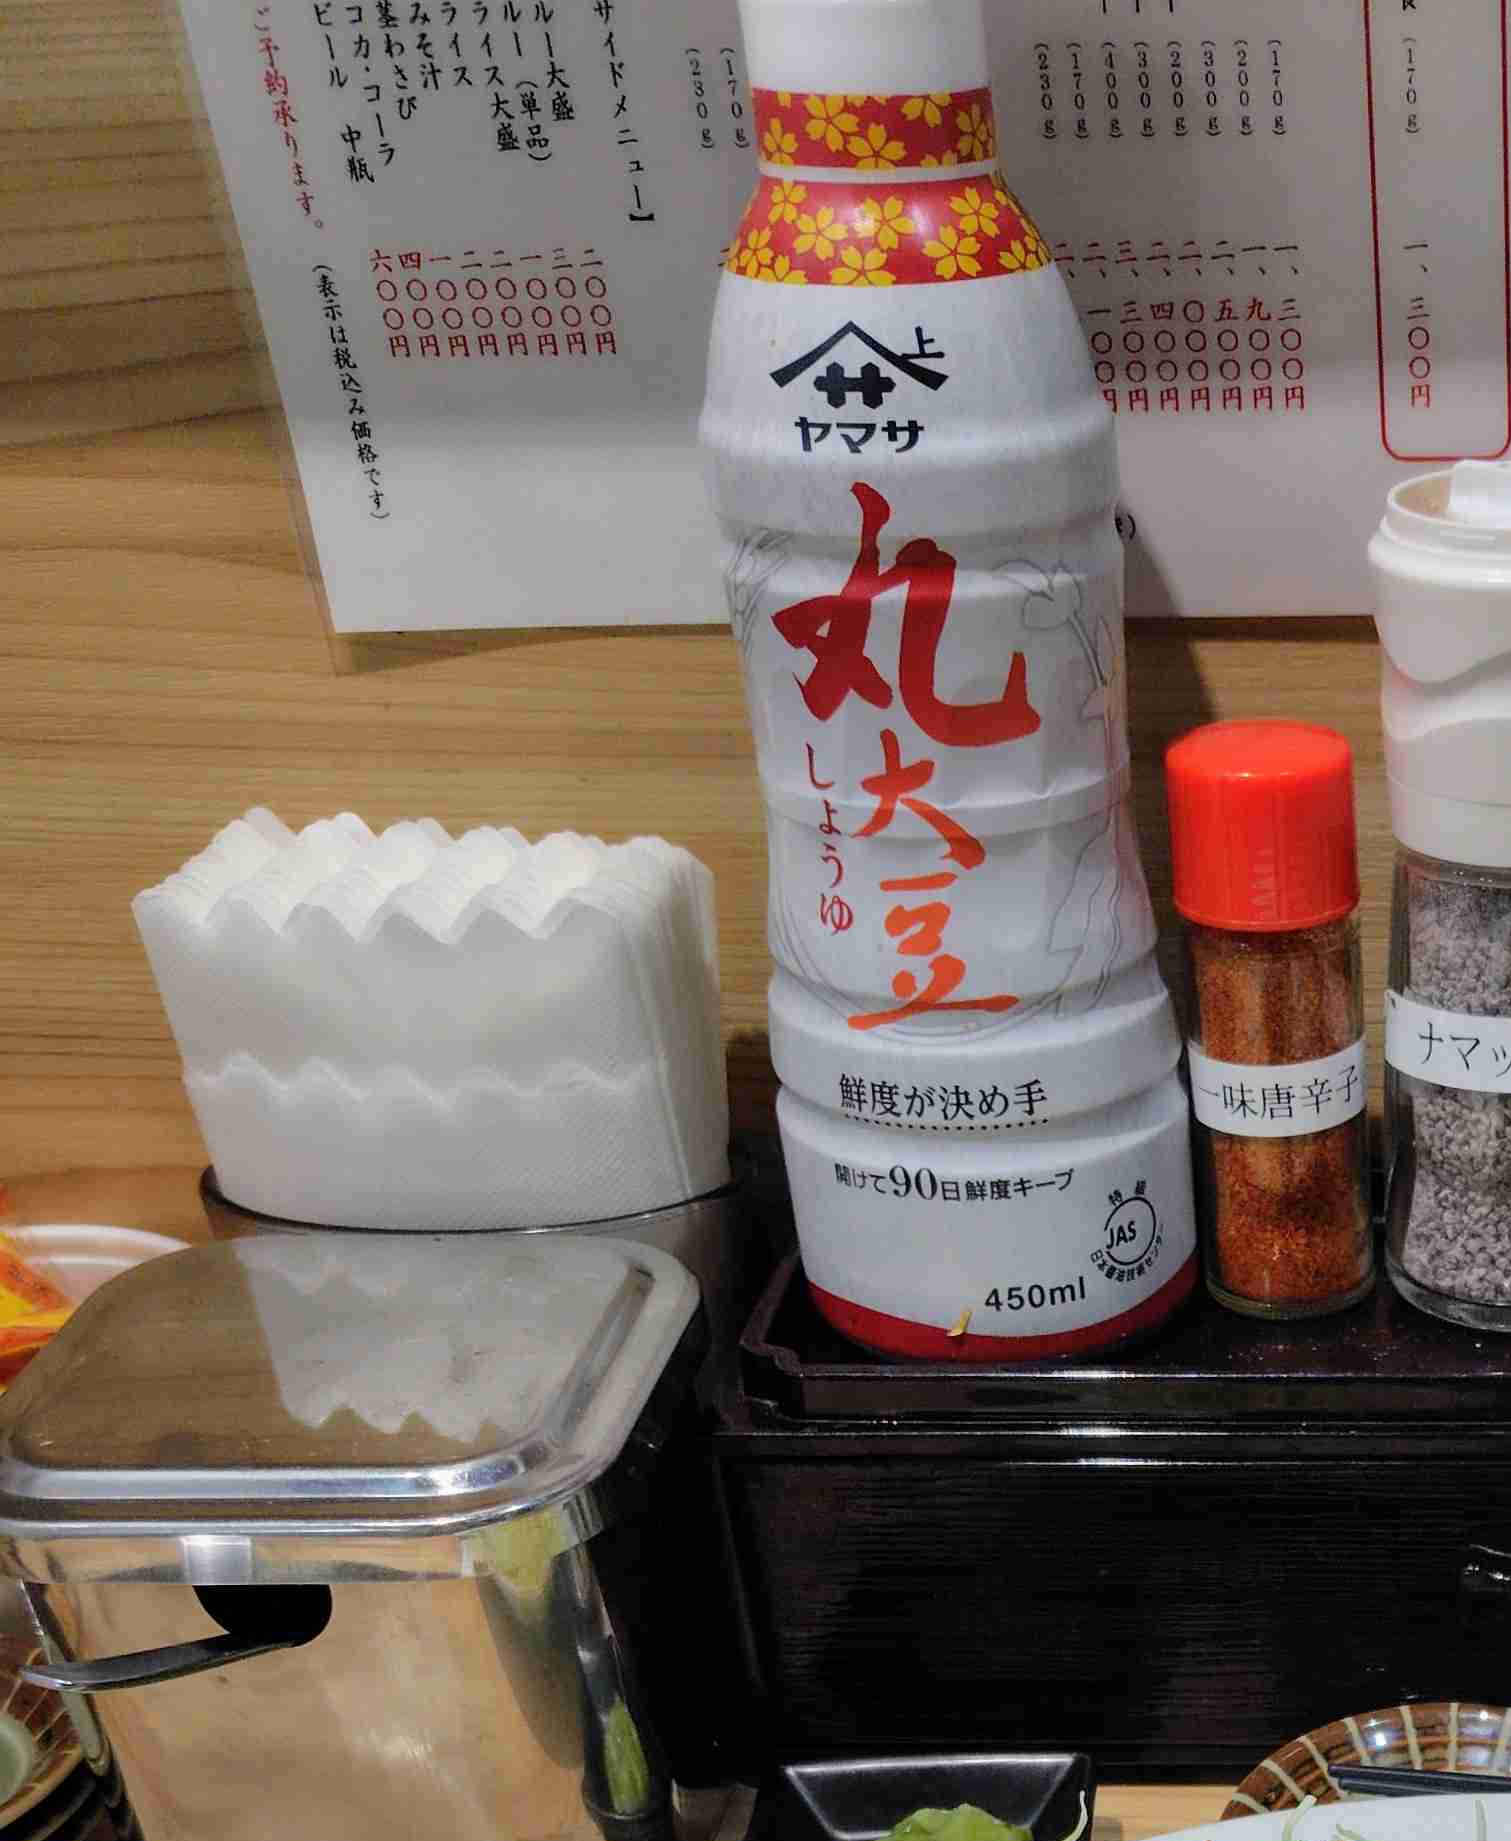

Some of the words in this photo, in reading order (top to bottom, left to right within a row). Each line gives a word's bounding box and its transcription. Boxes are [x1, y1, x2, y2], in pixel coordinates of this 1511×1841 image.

[409, 2, 442, 91] みそ汁
[441, 1, 472, 87] ライス
[341, 124, 376, 183] 中瓶
[795, 416, 924, 453] ヤマサ
[805, 742, 855, 937] しょうゆ
[838, 1073, 1049, 1121] 鮮度が決め手
[1199, 1065, 1359, 1121] 一味唐辛子
[1106, 1220, 1137, 1250] JAS
[984, 1276, 1086, 1312] 450ml
